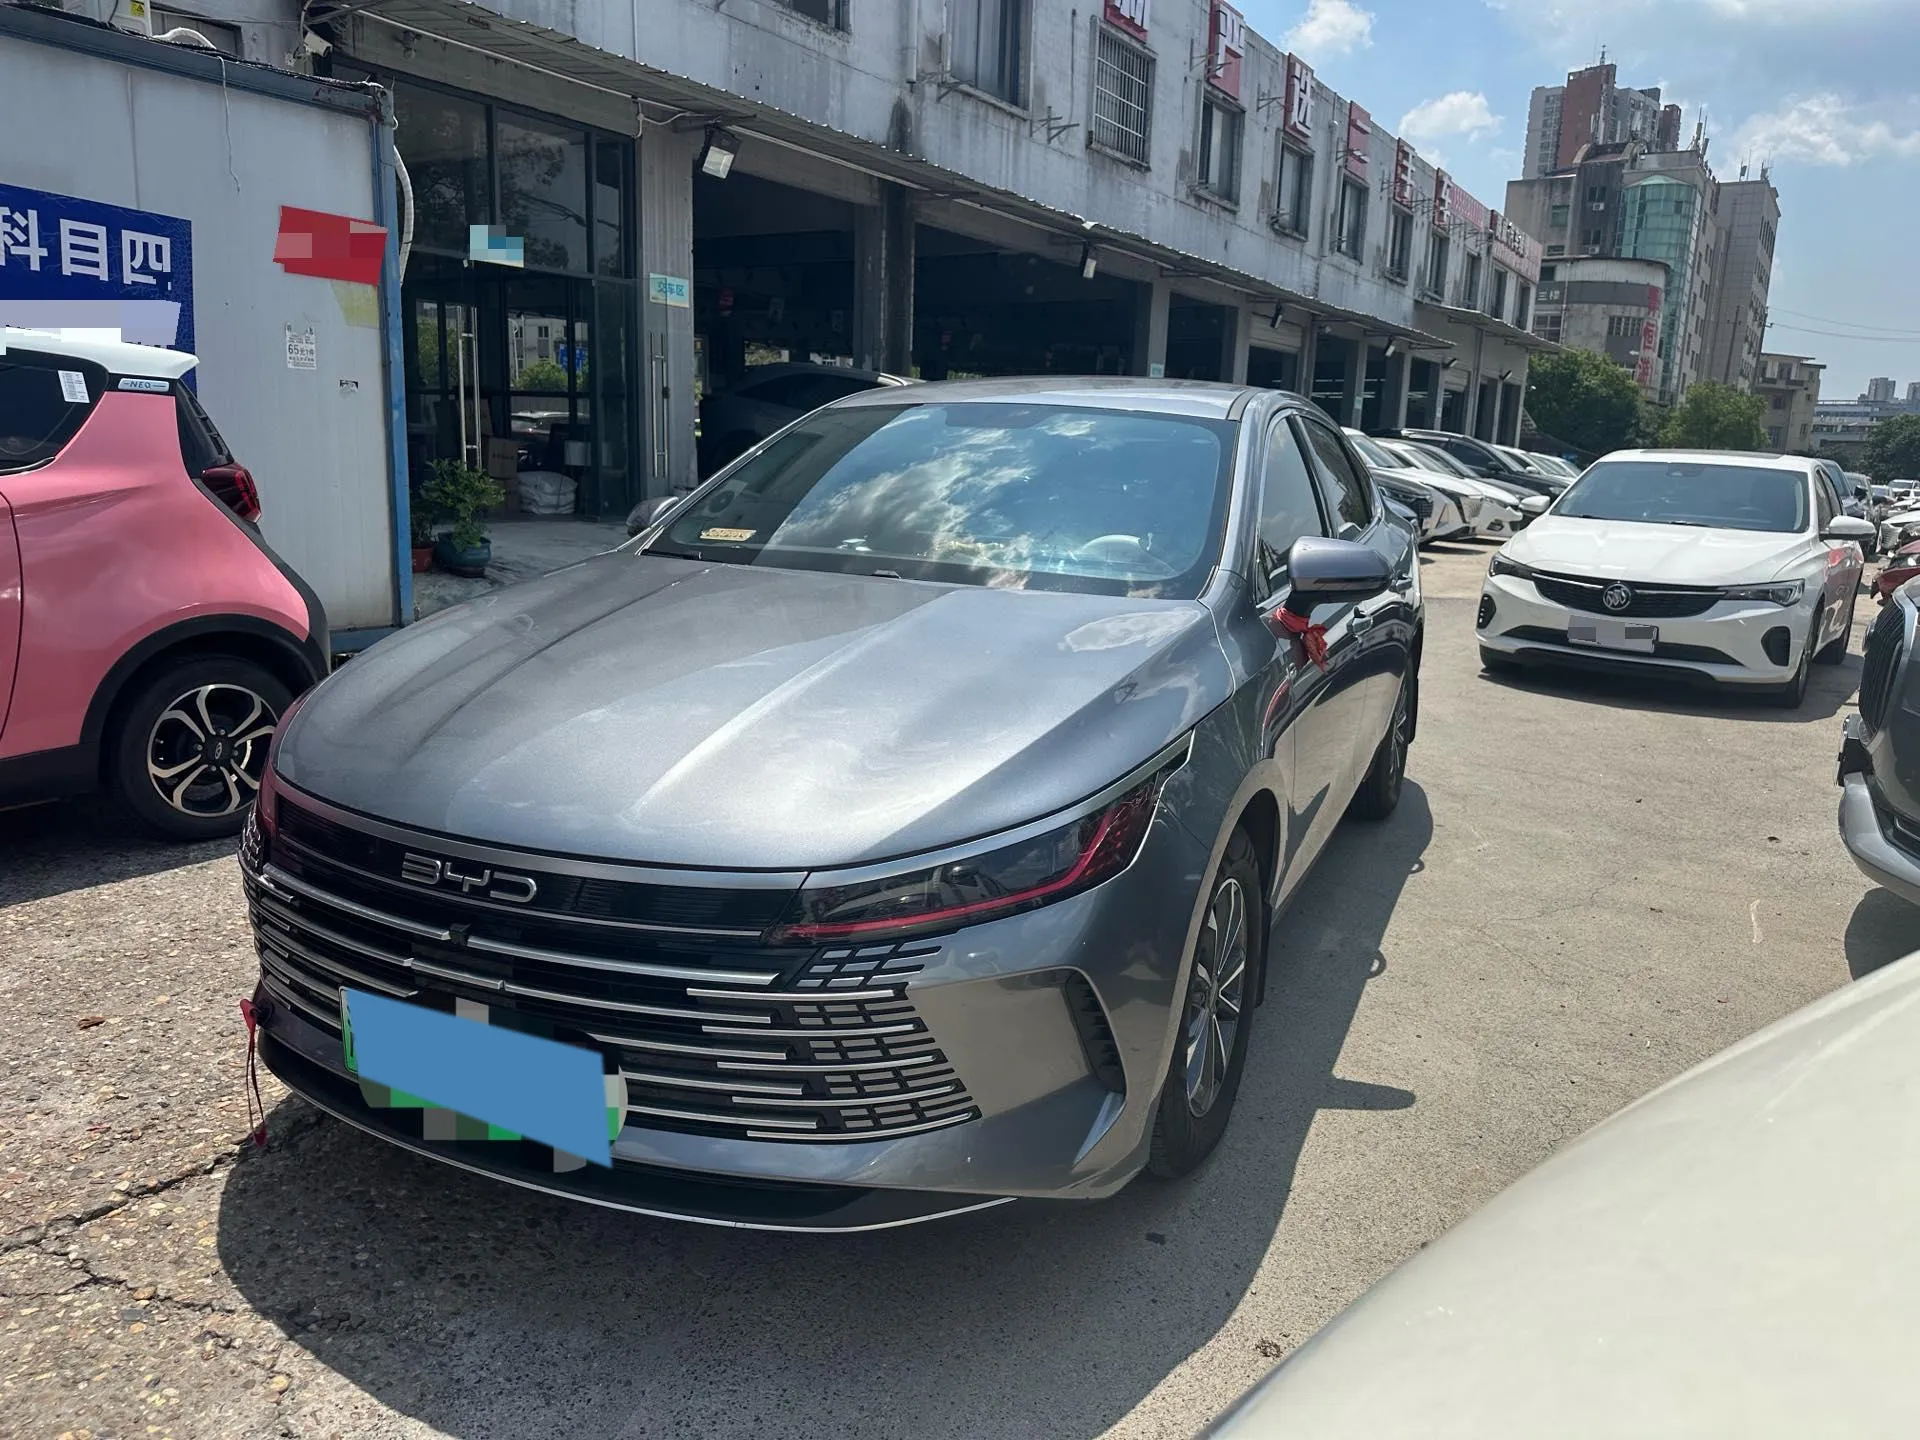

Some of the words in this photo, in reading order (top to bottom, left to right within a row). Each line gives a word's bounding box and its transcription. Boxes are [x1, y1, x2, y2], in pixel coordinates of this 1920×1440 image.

[0, 206, 171, 290] 科目四
[401, 852, 537, 903] BYD
